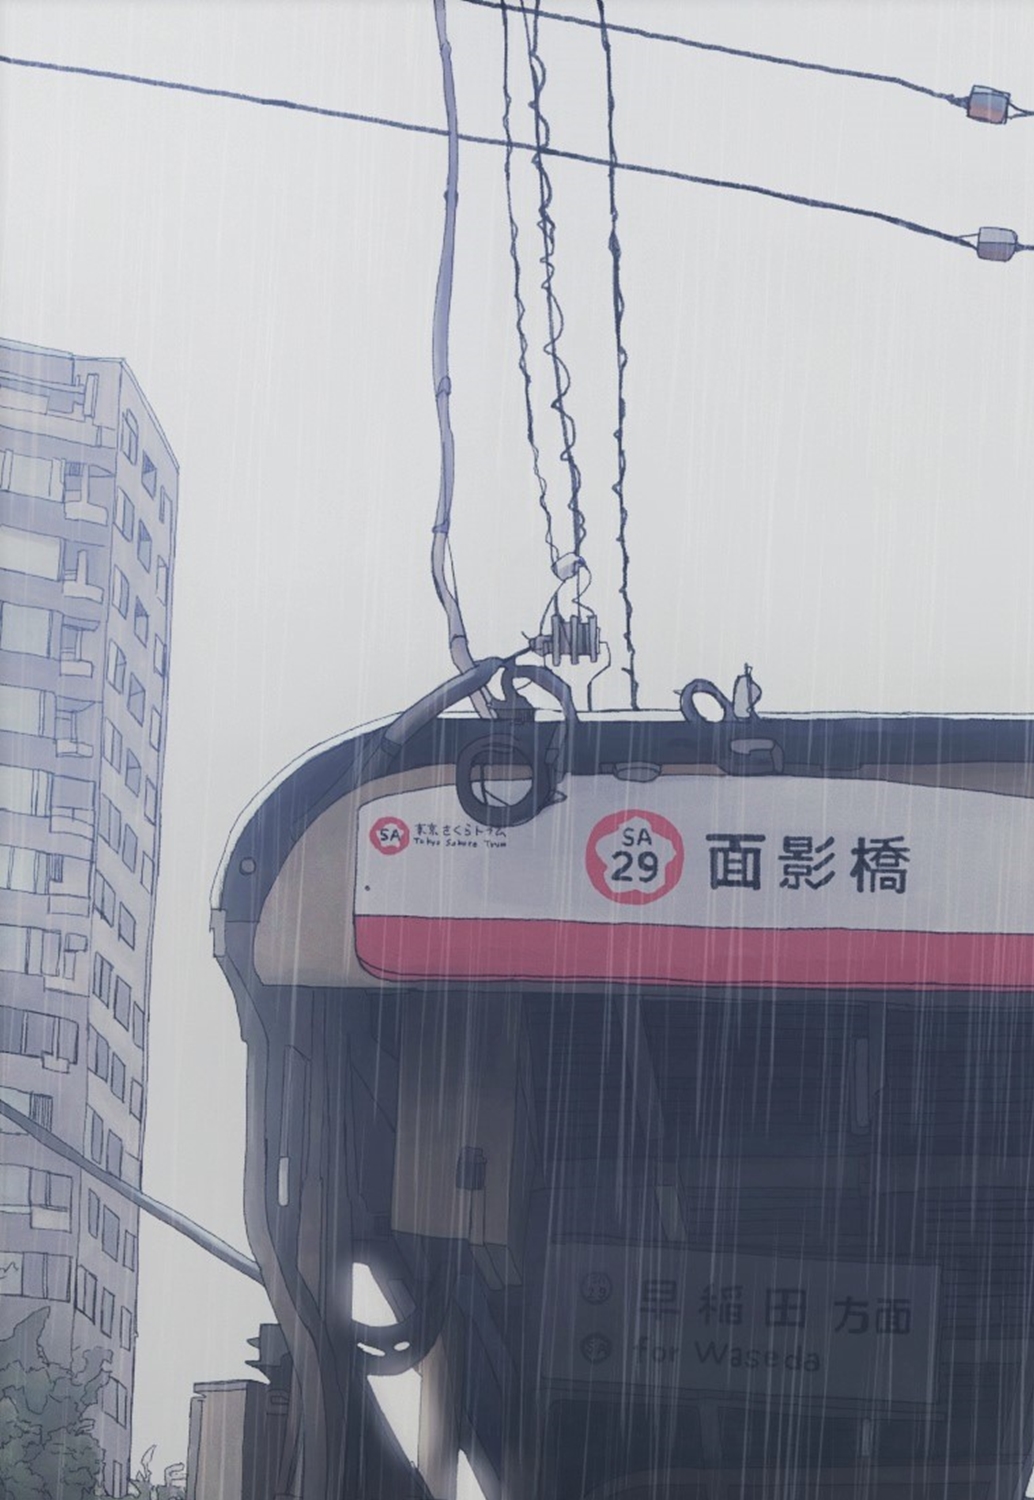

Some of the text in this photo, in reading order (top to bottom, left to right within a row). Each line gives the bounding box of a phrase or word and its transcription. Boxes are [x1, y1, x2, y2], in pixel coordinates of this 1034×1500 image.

[380, 828, 401, 841] SA
[621, 827, 652, 847] SA
[612, 851, 660, 883] 29
[705, 833, 911, 895] 面影橋
[633, 1336, 821, 1373] for Waseda
